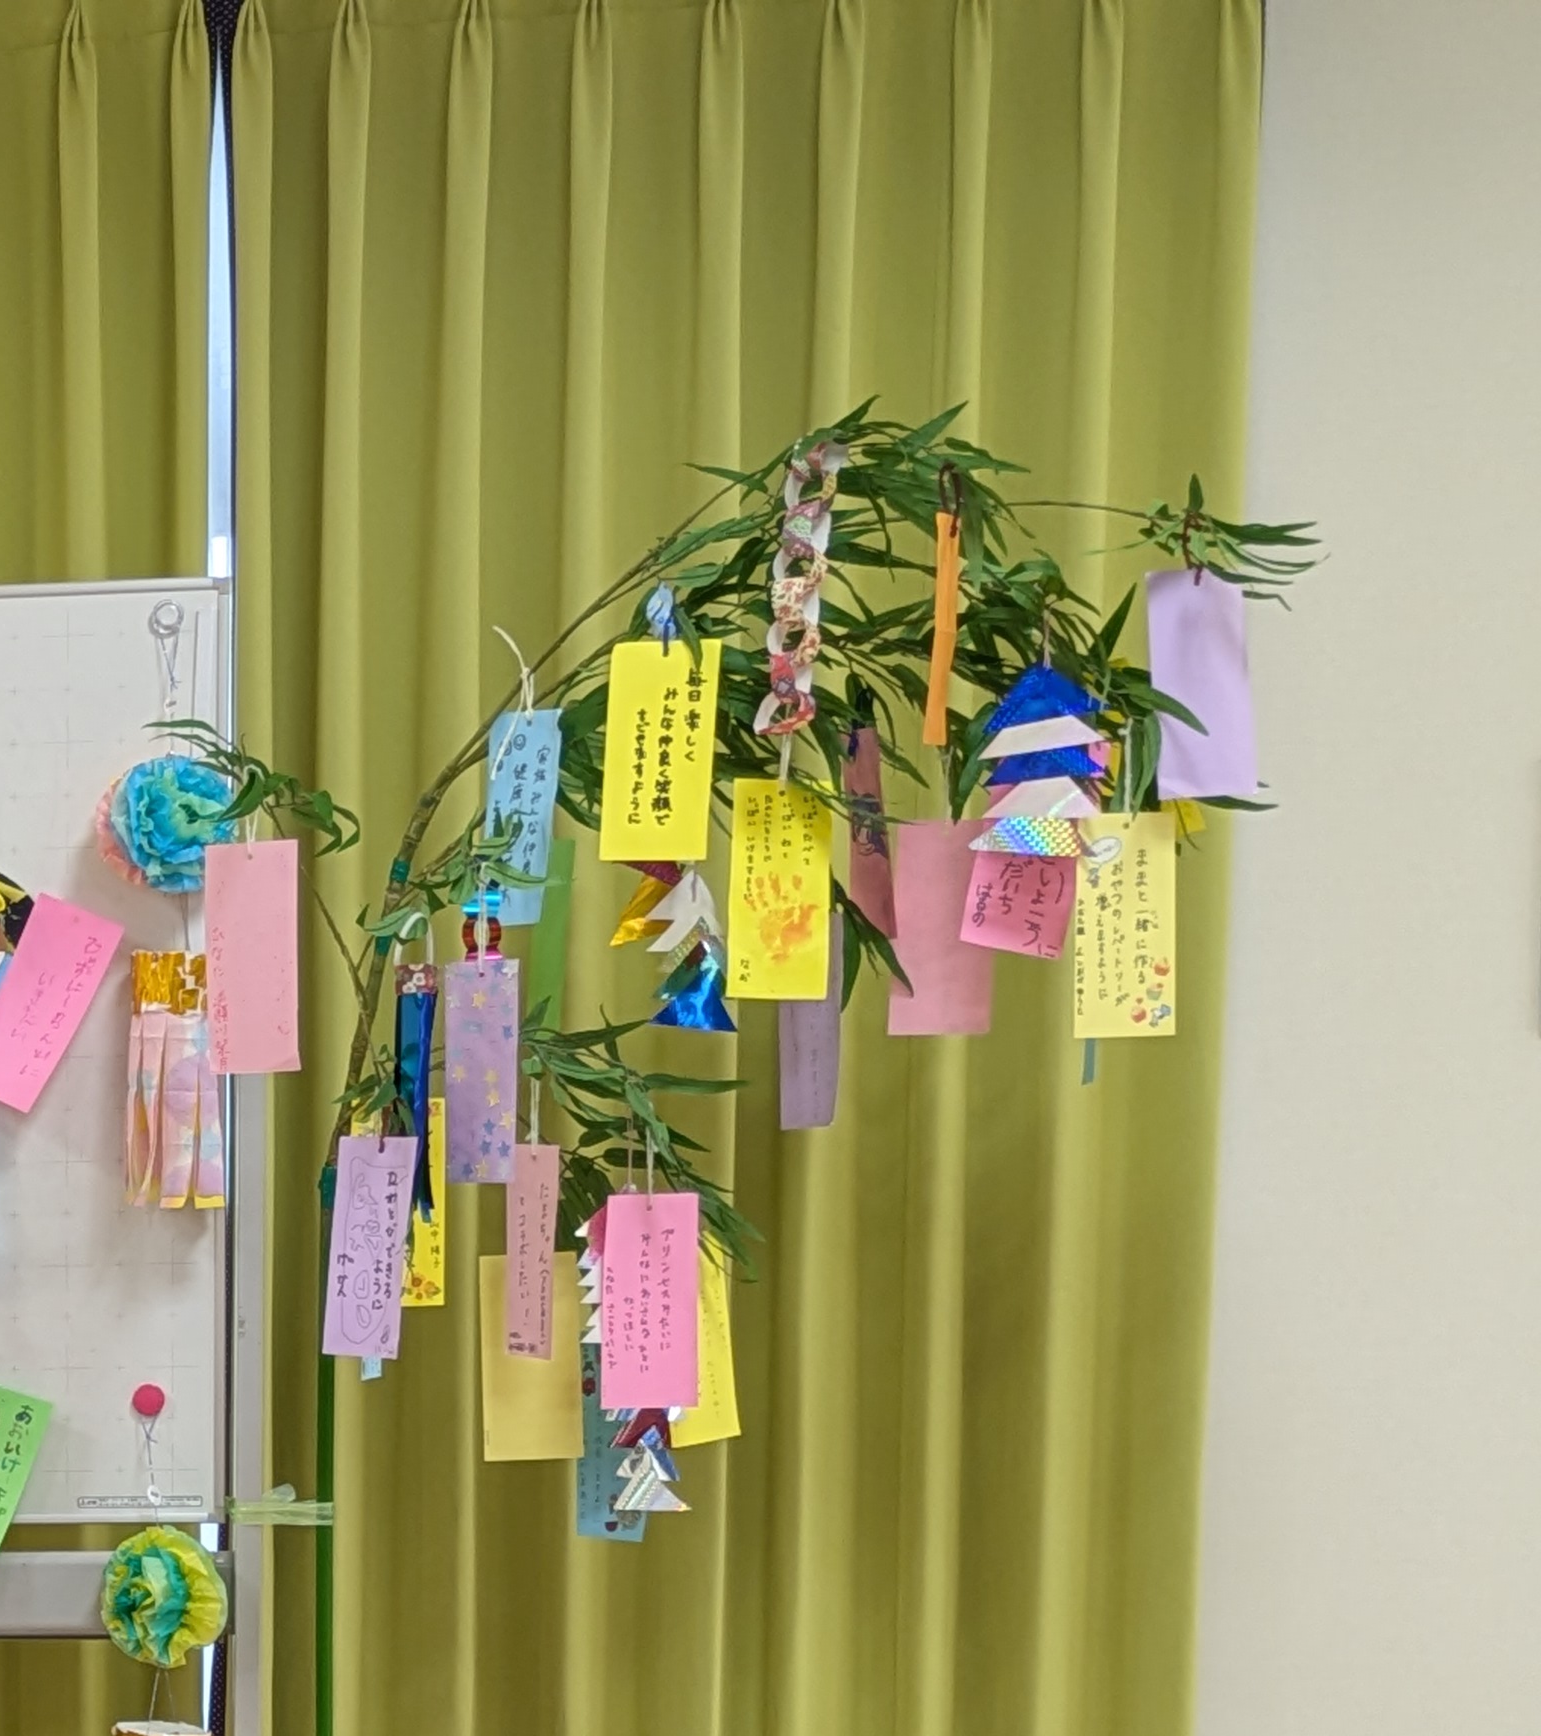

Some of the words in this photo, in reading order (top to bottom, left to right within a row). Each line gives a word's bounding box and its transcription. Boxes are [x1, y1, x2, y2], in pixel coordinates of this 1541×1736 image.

[685, 667, 707, 762] 毎日楽しく
